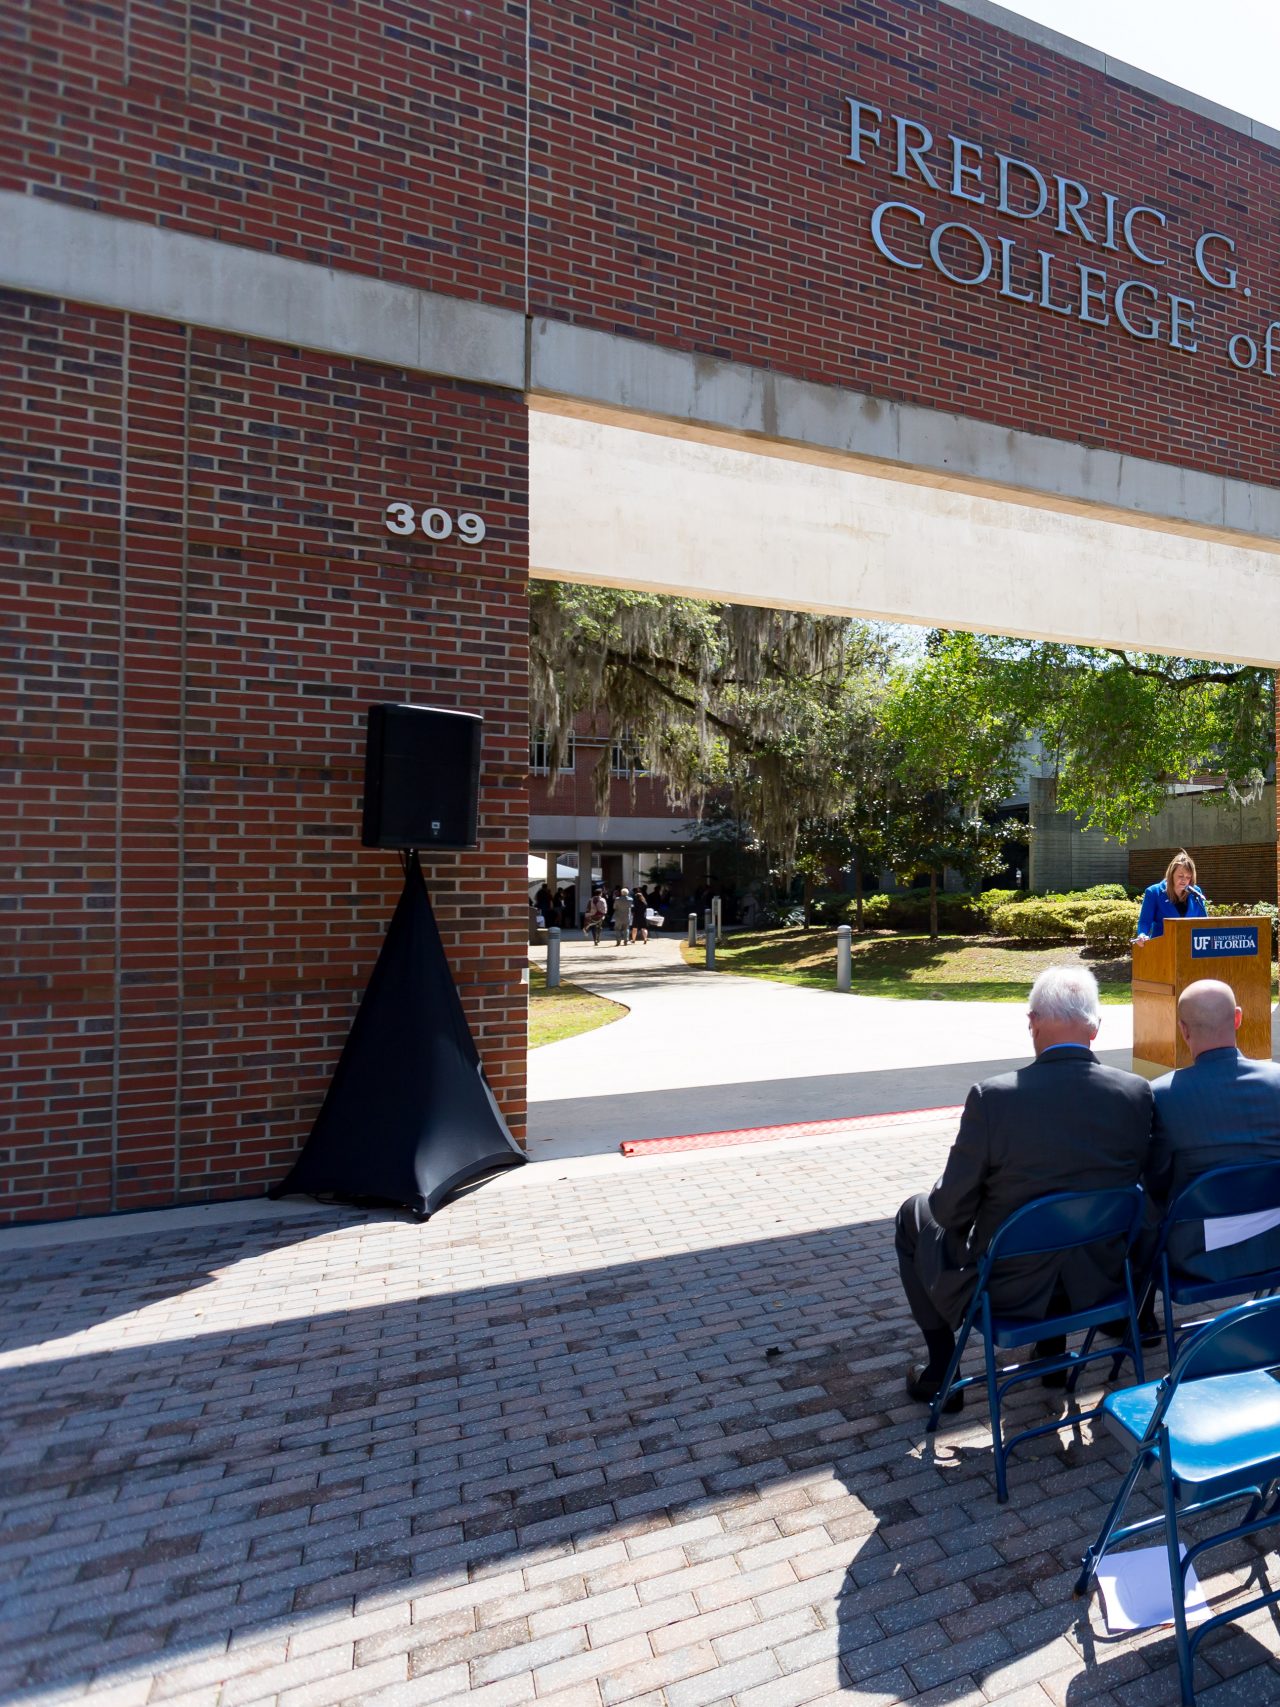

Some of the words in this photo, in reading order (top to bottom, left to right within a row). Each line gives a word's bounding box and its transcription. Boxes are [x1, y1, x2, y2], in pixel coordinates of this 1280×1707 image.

[844, 96, 1167, 266] FREDRIC
[1193, 231, 1253, 298] G.
[870, 201, 1198, 353] COLLEGE
[1227, 321, 1280, 377] of
[386, 503, 486, 544] 309
[1193, 936, 1211, 950] UF
[1214, 939, 1256, 949] FLORIDA
